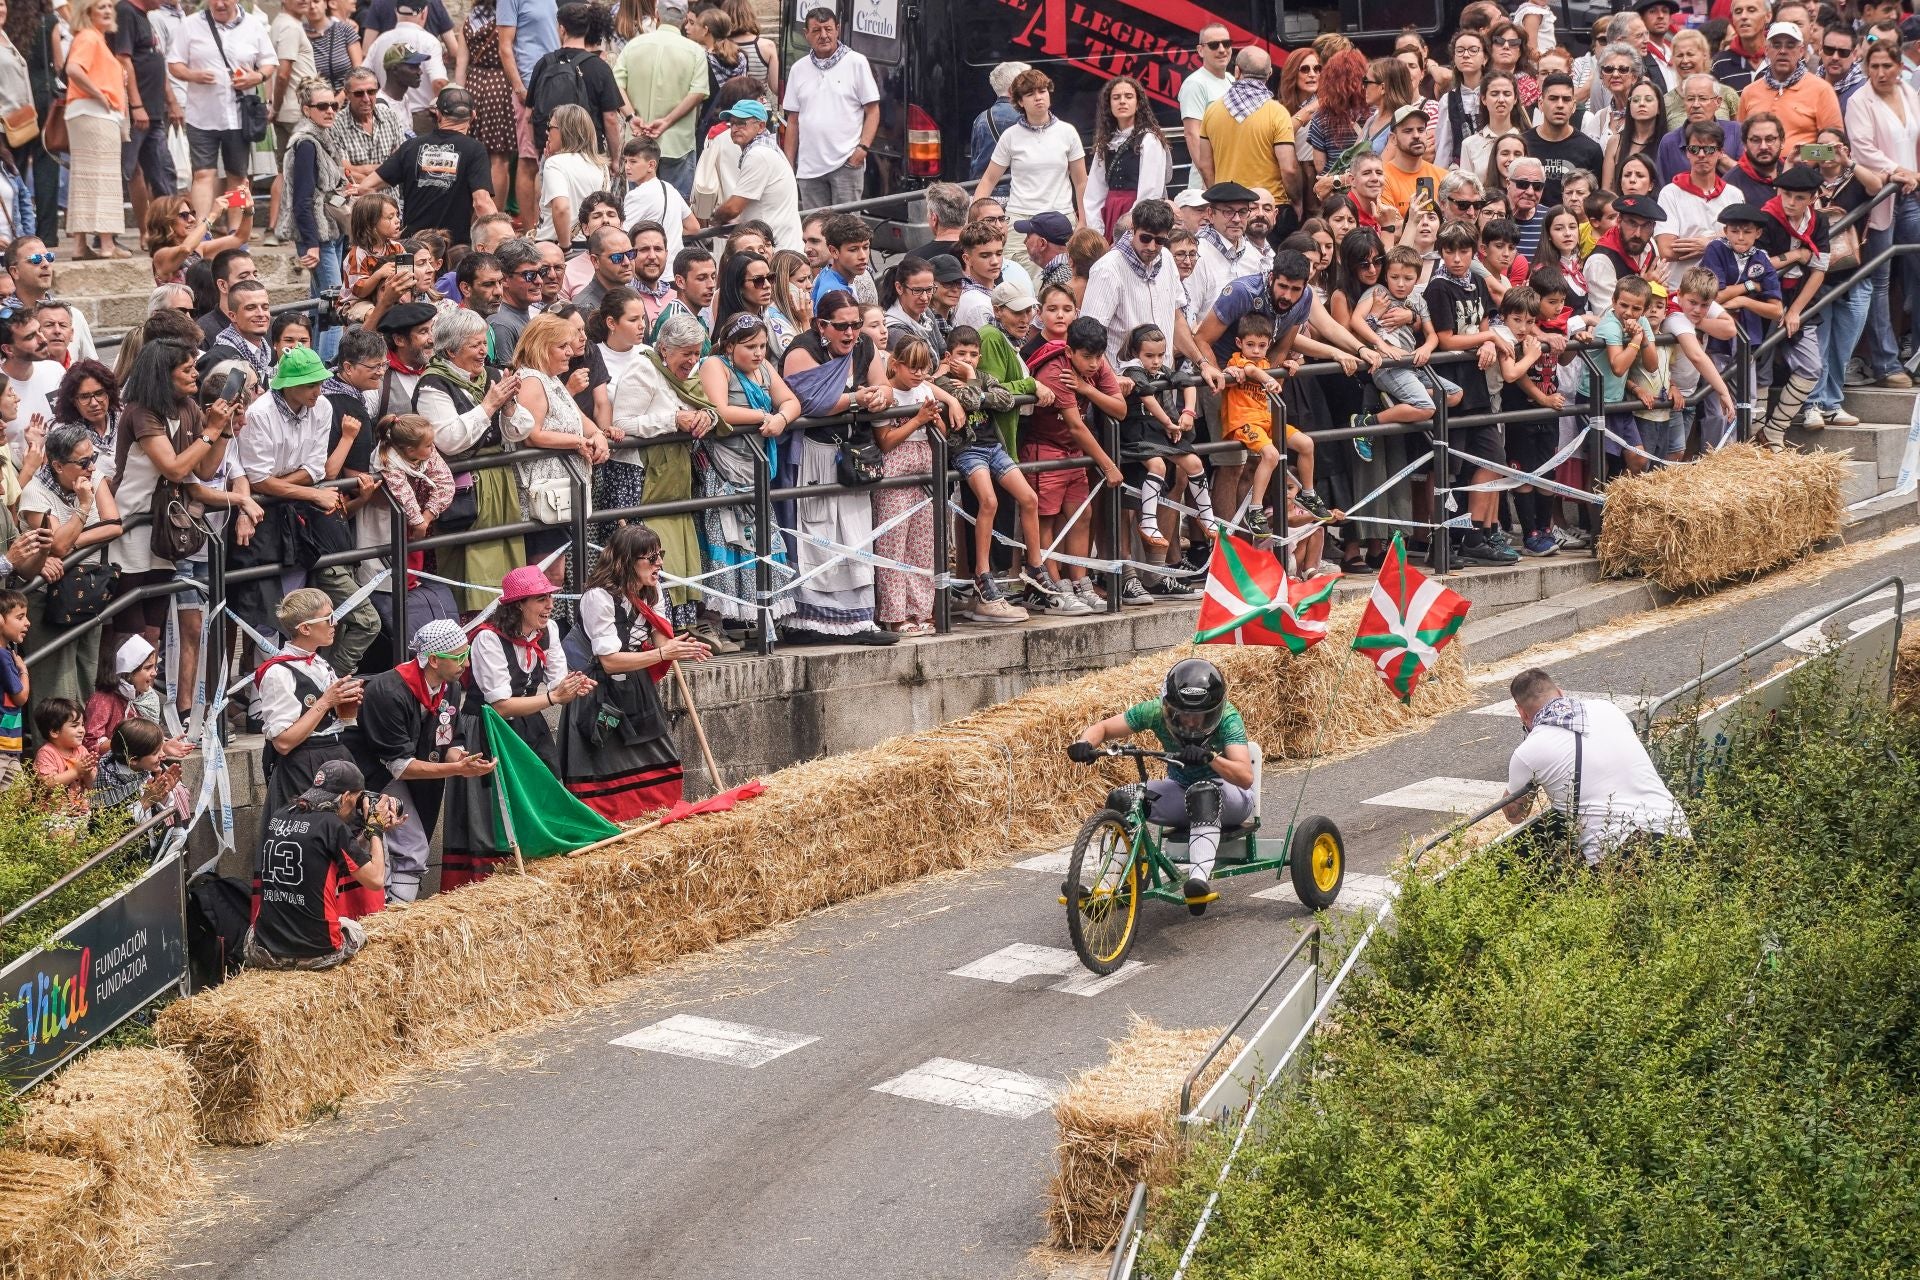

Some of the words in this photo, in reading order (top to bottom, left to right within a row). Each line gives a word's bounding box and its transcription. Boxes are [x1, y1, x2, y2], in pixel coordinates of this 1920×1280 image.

[856, 10, 893, 36] Círculo
[1543, 165, 1562, 174] RTH
[1545, 158, 1562, 166] THE
[223, 803, 235, 833] Vital
[261, 839, 304, 886] 13
[95, 927, 148, 979] FUNDACIÓN
[96, 954, 149, 1005] FUNDAZIOA
[18, 946, 91, 1055] Vital
